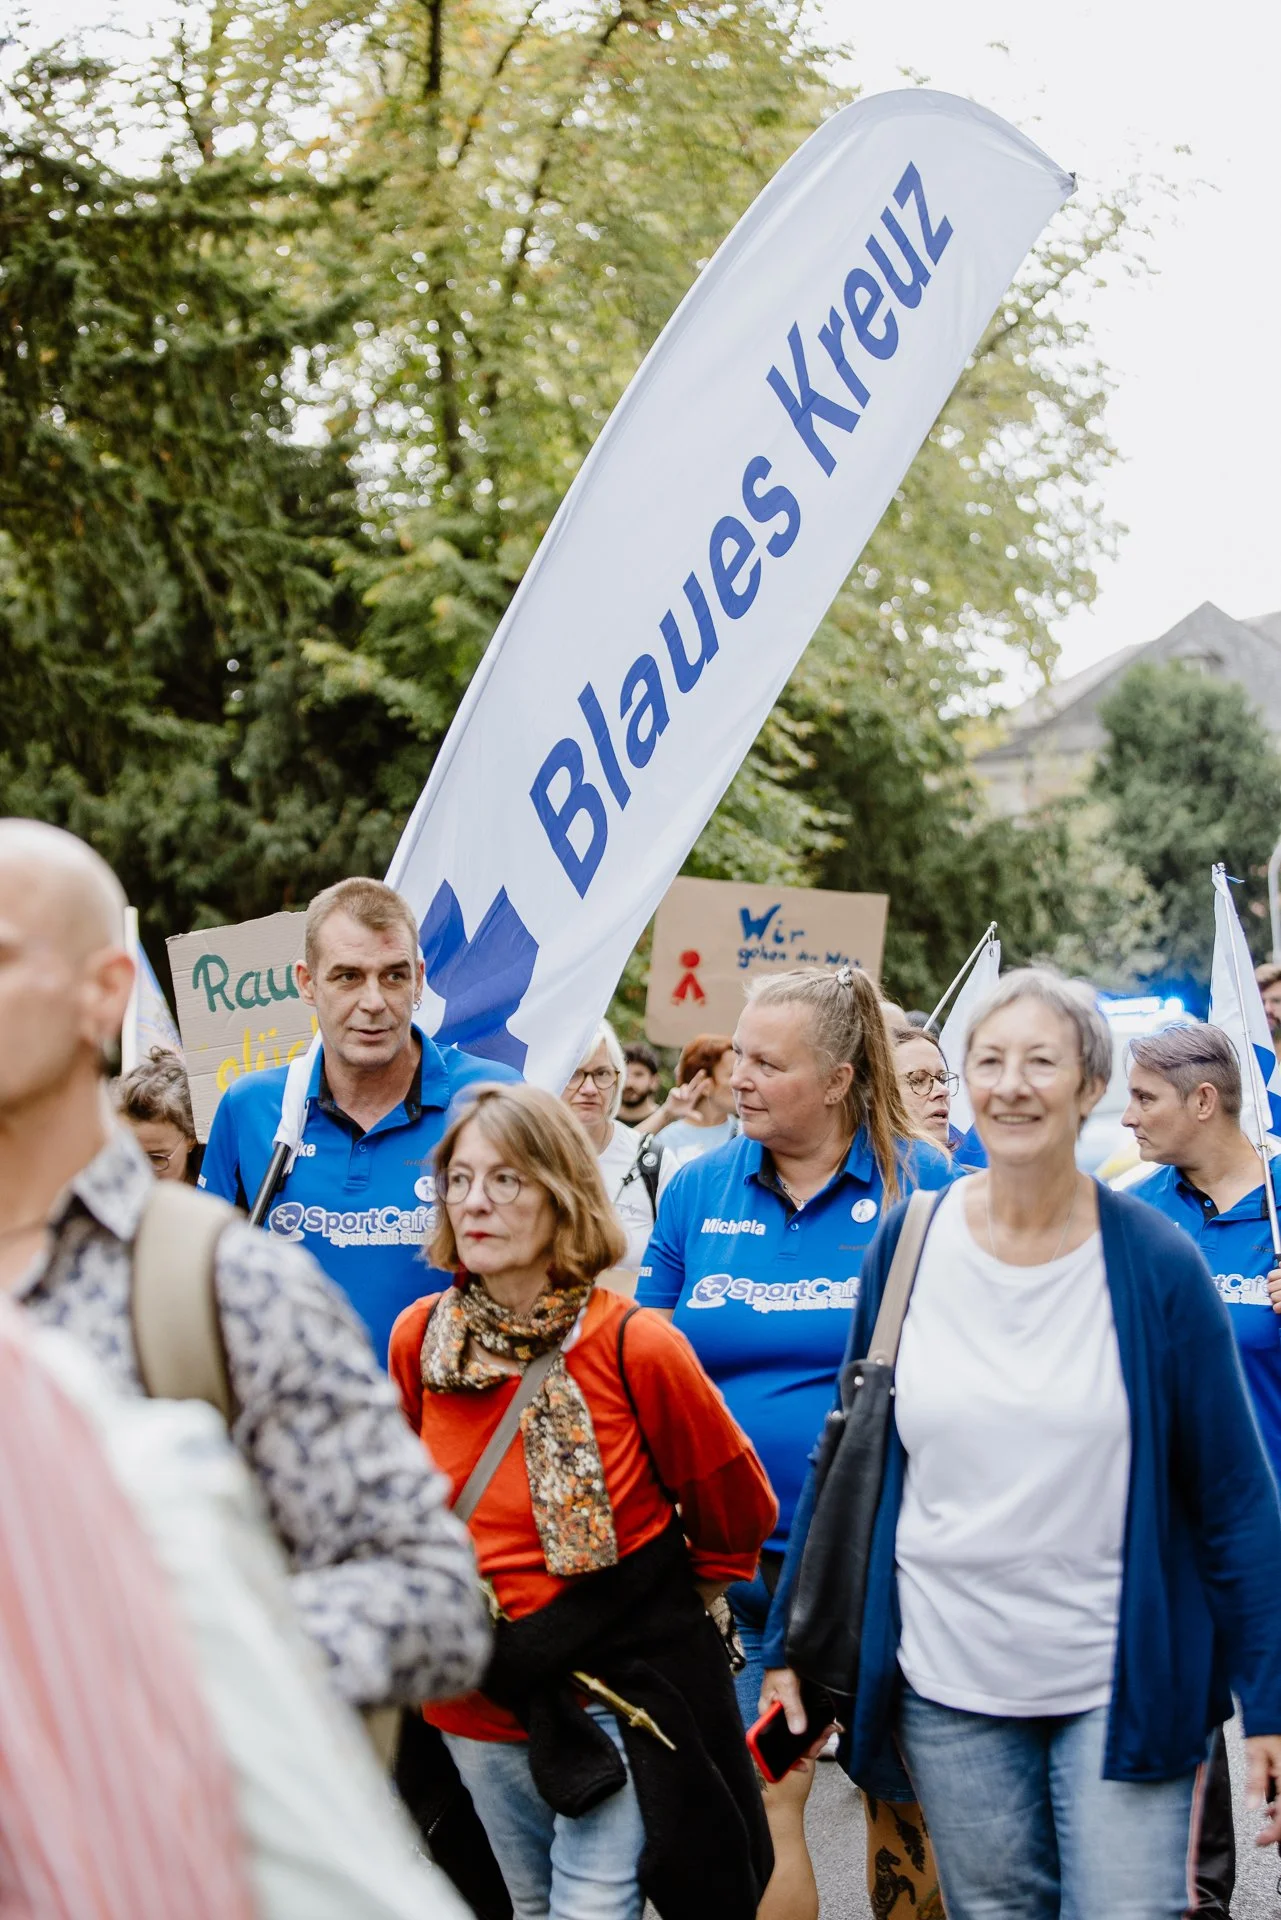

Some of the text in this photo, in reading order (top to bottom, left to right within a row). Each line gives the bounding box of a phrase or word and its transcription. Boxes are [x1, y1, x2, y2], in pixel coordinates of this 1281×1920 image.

[530, 161, 954, 899] Blaues Kreuz
[739, 903, 806, 944] Wir
[192, 954, 300, 1013] Rau
[727, 1276, 860, 1305] SportCaf
